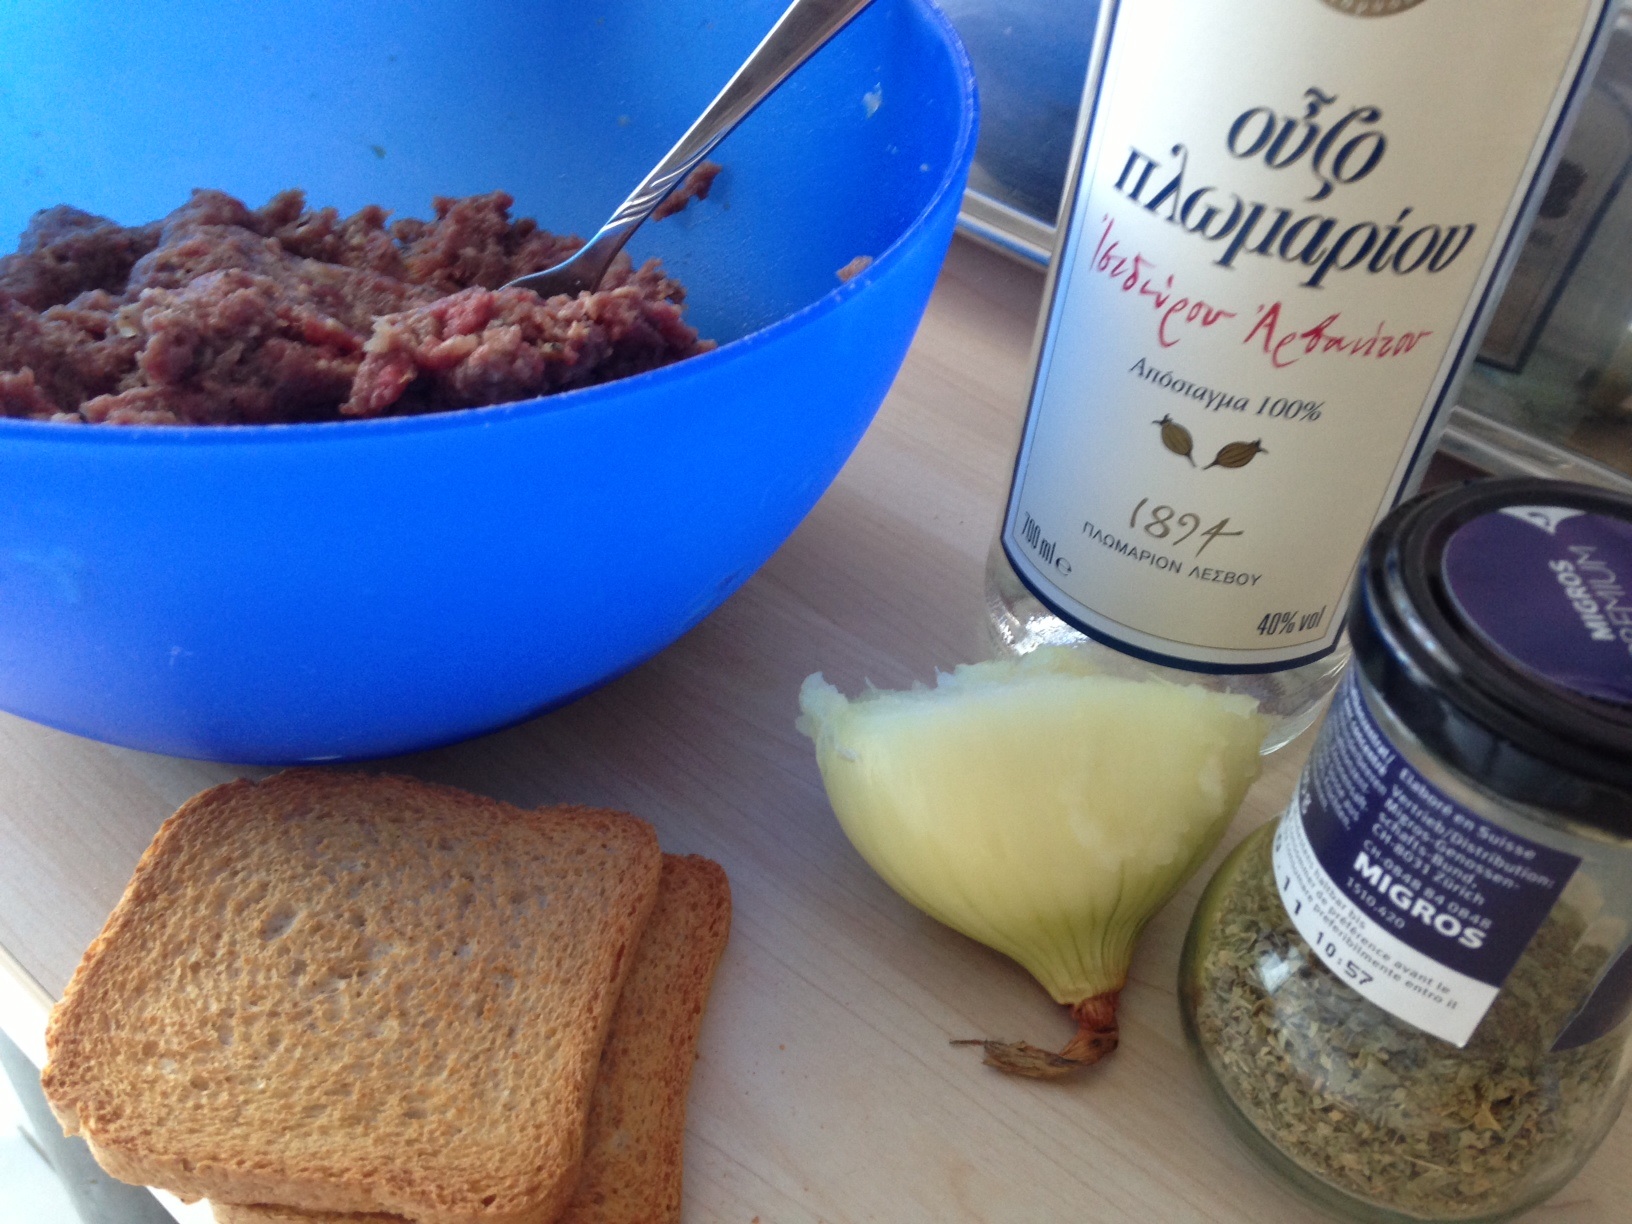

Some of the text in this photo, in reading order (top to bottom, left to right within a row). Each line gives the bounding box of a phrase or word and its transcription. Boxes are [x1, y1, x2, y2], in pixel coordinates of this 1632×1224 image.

[1113, 143, 1478, 288] πλωμαρίου
[1129, 357, 1325, 422] Απόσταγμα 100%
[1022, 510, 1041, 549] 700
[1039, 538, 1056, 564] ml
[1082, 520, 1263, 587] ΠΛΩΜΑΡΙΟΝ ΛΕΣΒΟΥ
[1130, 497, 1245, 558] 1894
[1257, 605, 1327, 637] 40% vol
[1549, 560, 1616, 641] MIGROS
[1399, 767, 1453, 816] Elaboré
[1453, 813, 1475, 831] en
[1477, 826, 1536, 860] Suisse
[1349, 909, 1366, 929] bis
[1353, 851, 1487, 949] MIGROS
[1433, 871, 1485, 906] Zürich
[1394, 960, 1433, 986] avant
[1405, 979, 1443, 1003] entro
